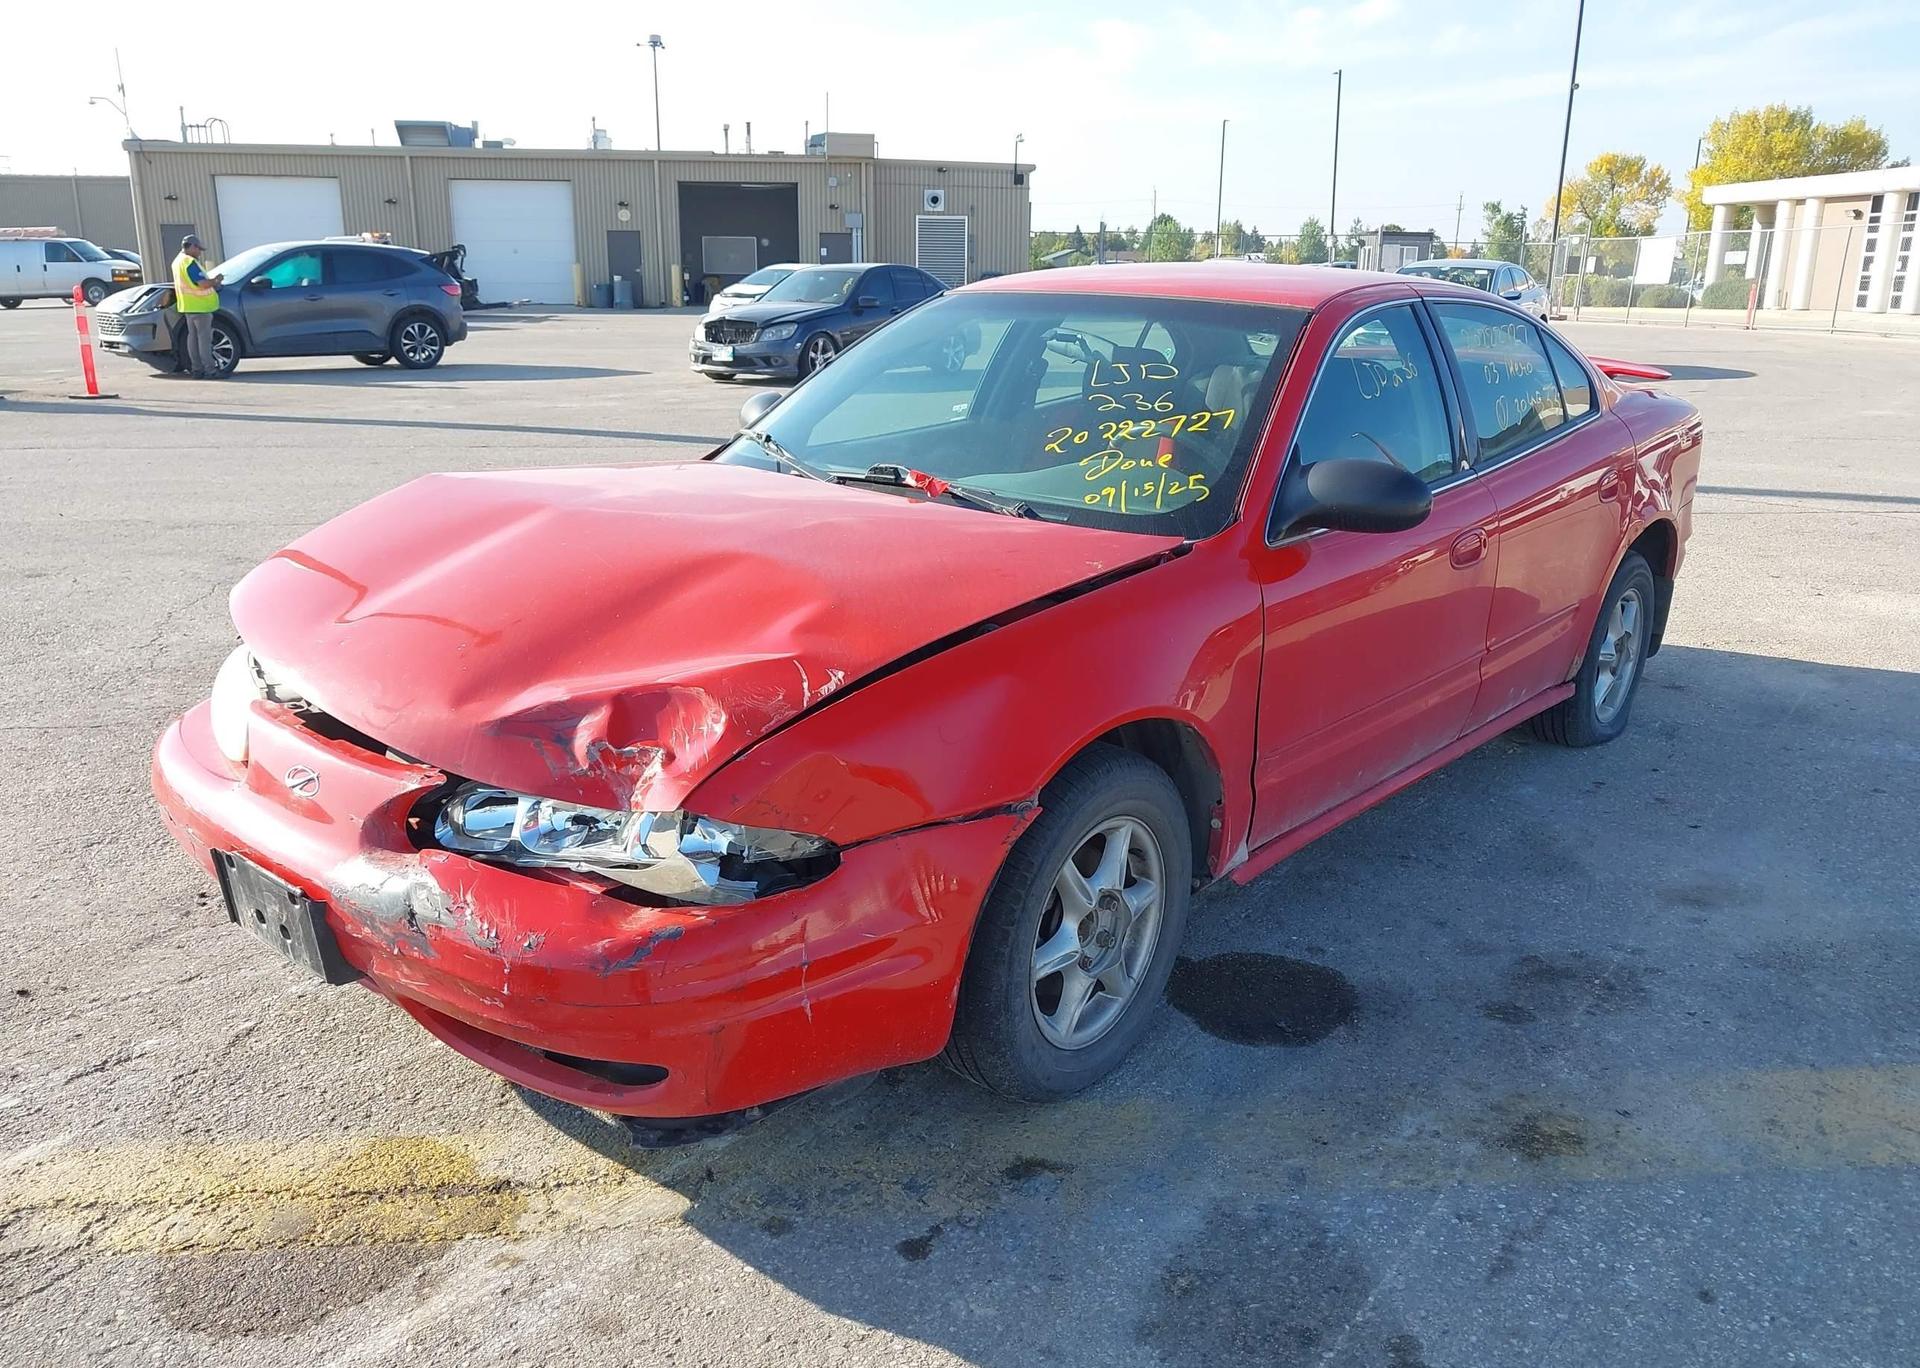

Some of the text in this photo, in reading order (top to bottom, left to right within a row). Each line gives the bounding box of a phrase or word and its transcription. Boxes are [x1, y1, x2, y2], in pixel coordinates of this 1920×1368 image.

[1091, 360, 1179, 387] LJD
[1088, 391, 1174, 412] 236
[1080, 450, 1173, 480] Done
[1084, 473, 1210, 513] 09/15/25
